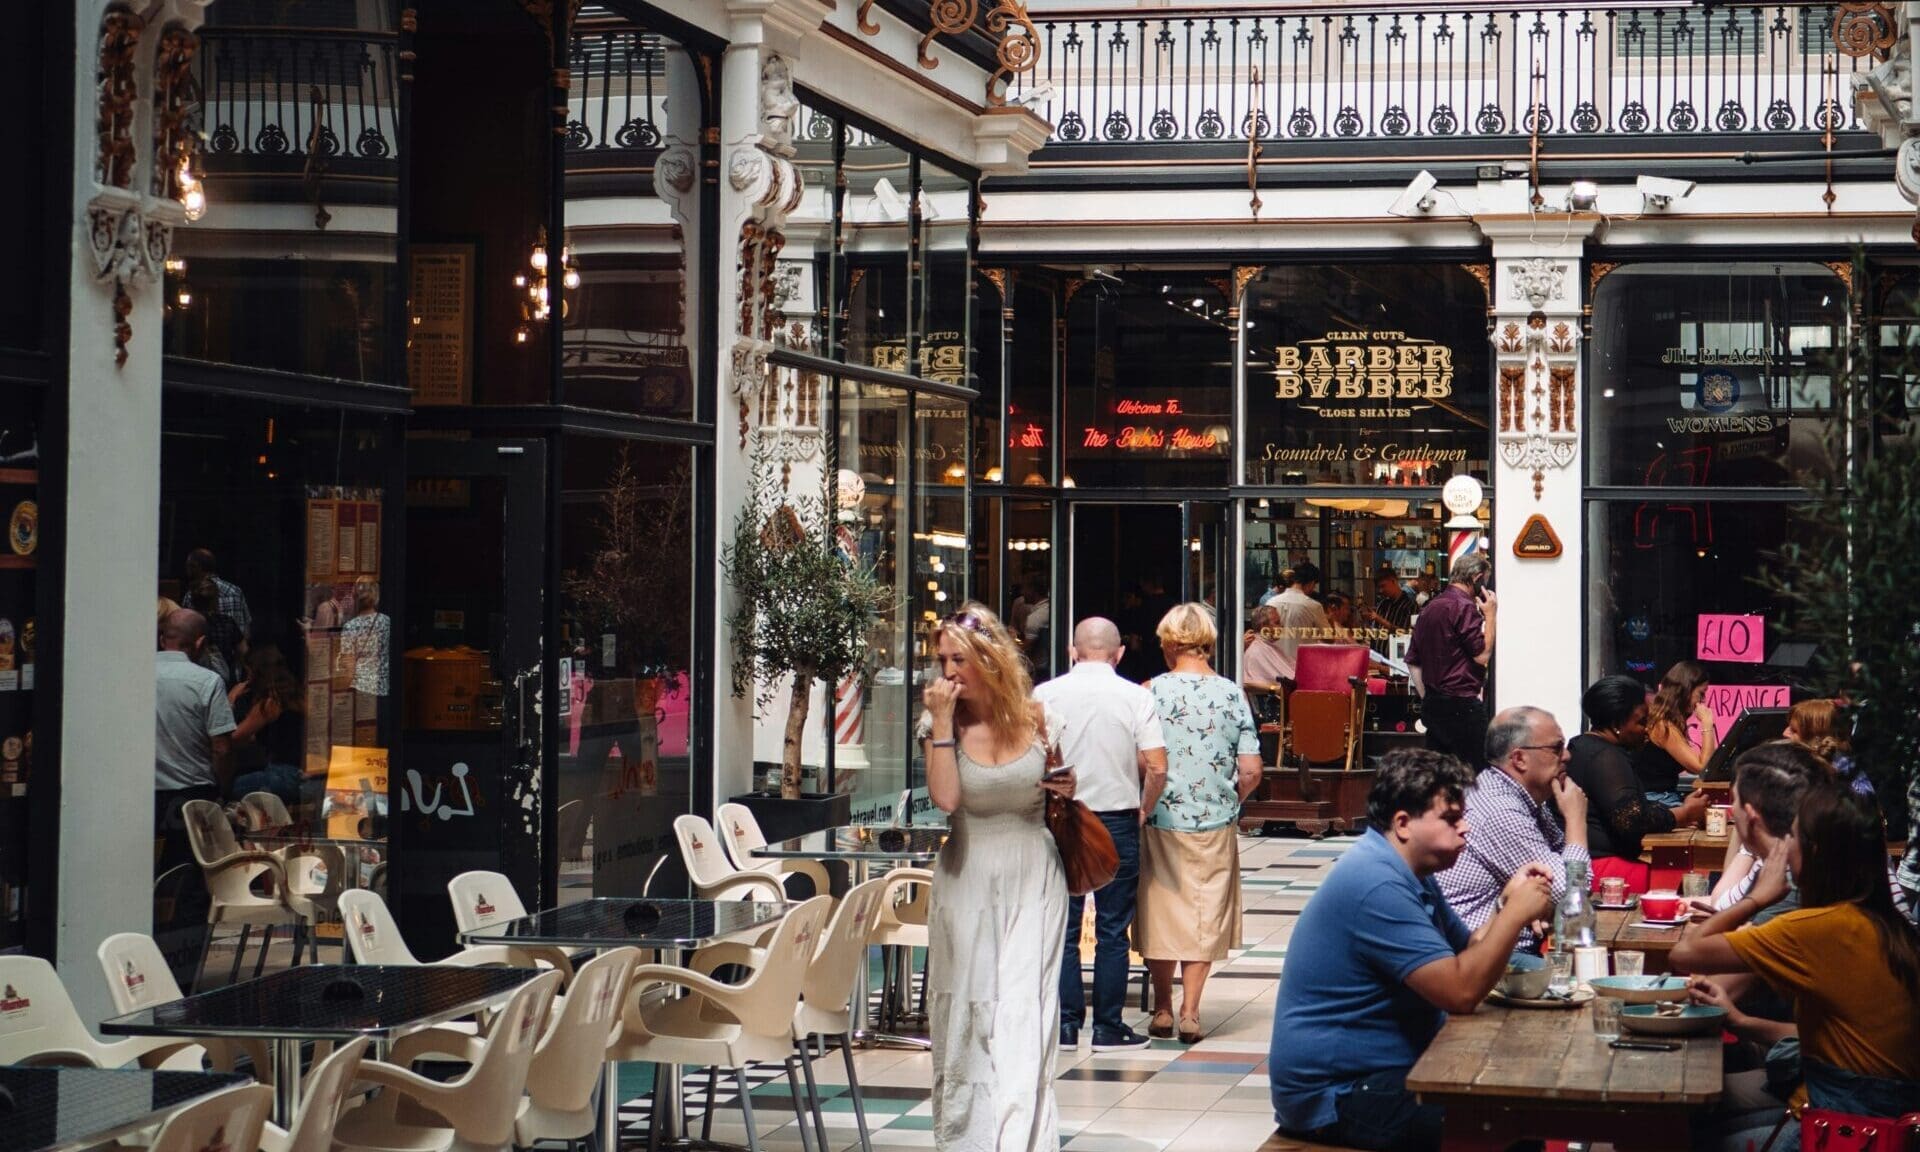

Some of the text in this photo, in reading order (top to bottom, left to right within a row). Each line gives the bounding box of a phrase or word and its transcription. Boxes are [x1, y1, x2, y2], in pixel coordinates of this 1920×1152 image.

[1326, 331, 1405, 341] CLEAN CUTS
[1275, 346, 1454, 371] BARBER
[1699, 347, 1774, 365] BLACK
[1117, 400, 1162, 414] Welcome
[1319, 409, 1411, 418] CLOSE SHAVES
[1666, 416, 1773, 434] WOMENS
[1083, 429, 1109, 447] The
[1172, 429, 1216, 448] House
[1262, 443, 1467, 461] Scoundrels & Gentlemen
[1260, 626, 1389, 641] GENTLEMENS
[1702, 620, 1750, 655] £10
[1707, 688, 1786, 717] ARANCE
